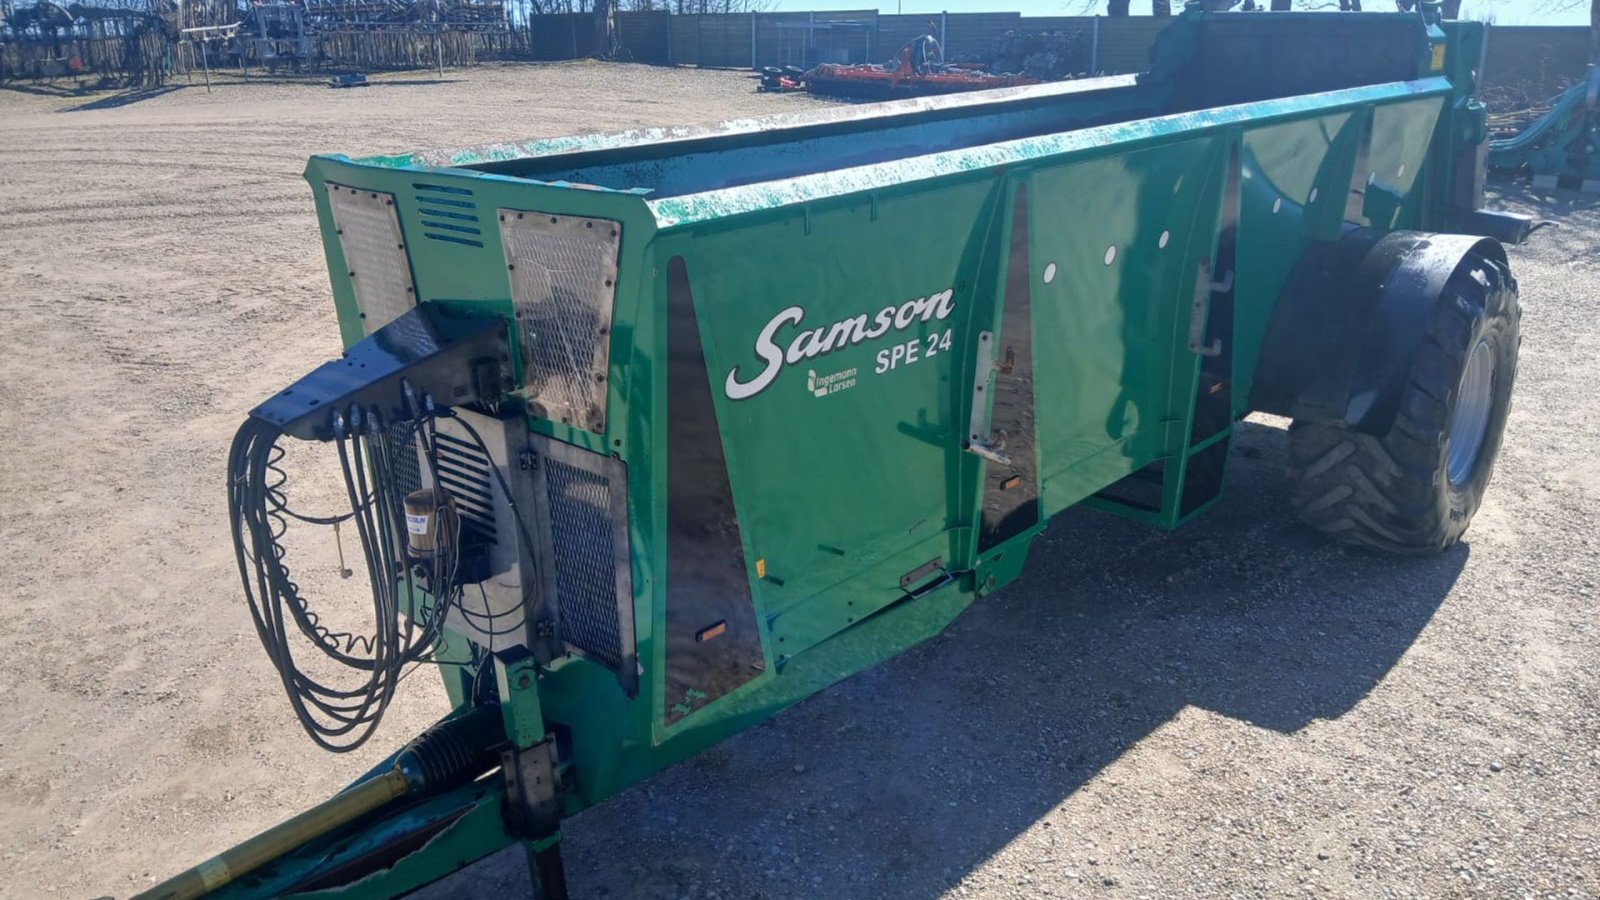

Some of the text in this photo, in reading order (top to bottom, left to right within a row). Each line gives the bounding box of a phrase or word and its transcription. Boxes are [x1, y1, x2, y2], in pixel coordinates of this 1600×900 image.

[725, 288, 955, 400] Samson
[875, 328, 952, 374] SPE 24
[816, 368, 857, 387] Ingemann
[829, 379, 856, 394] Larsen
